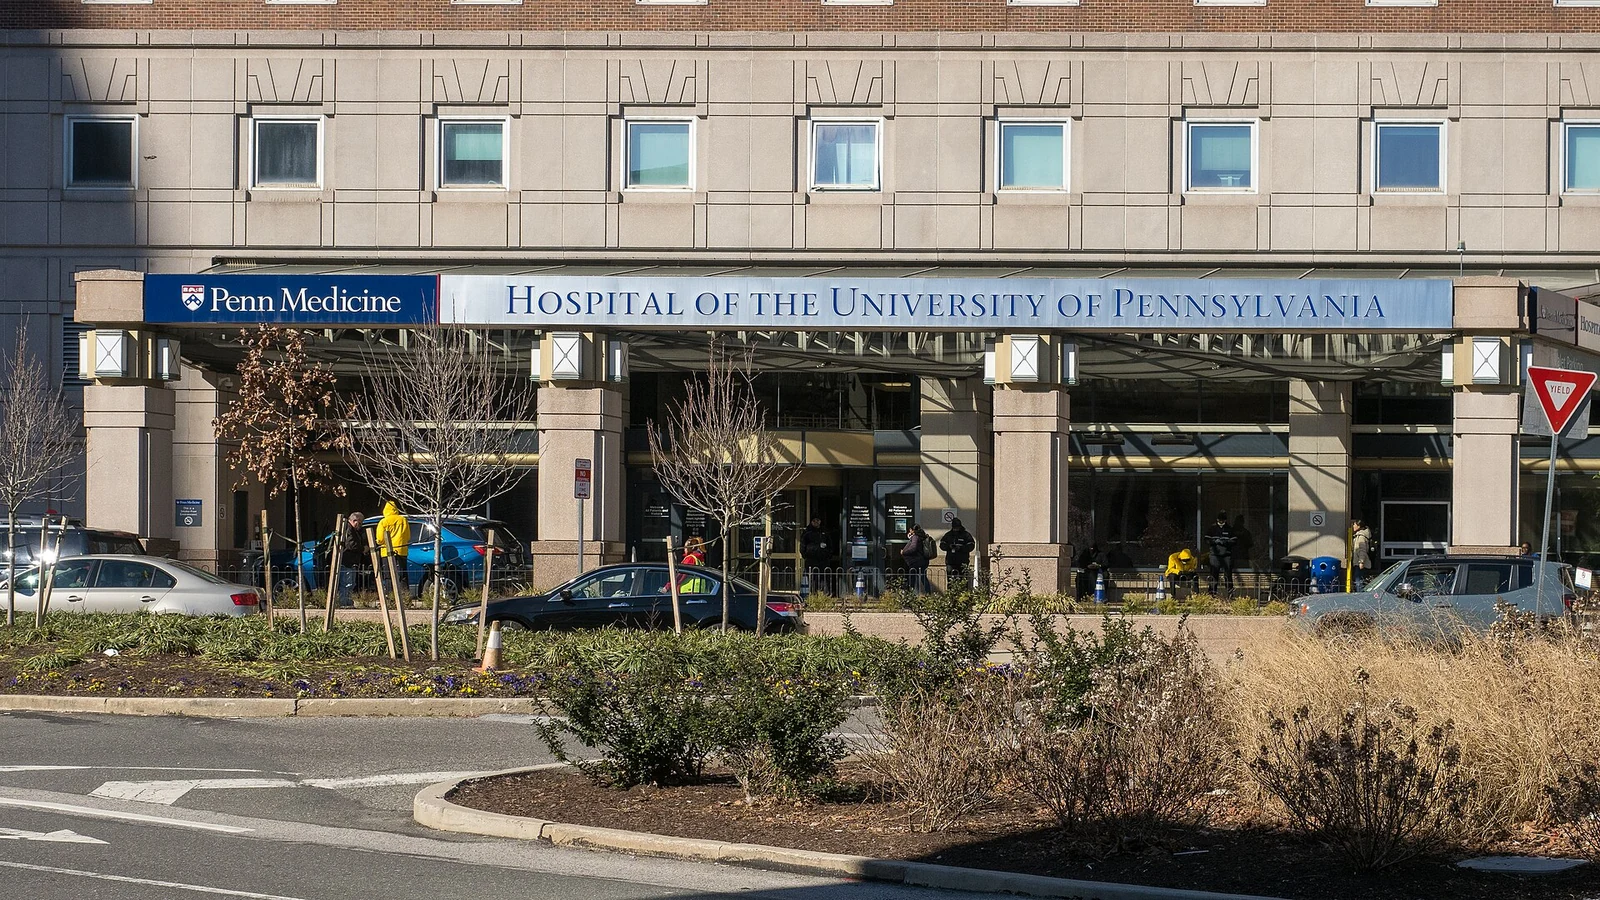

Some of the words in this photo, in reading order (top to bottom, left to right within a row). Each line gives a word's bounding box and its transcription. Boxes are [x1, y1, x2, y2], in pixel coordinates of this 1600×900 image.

[210, 287, 275, 312] Penn
[279, 285, 402, 313] Medicine
[506, 285, 685, 316] HOSPITAL
[695, 291, 740, 316] OF
[749, 293, 820, 317] THE
[830, 287, 1046, 318] UNIVERSITY
[1057, 293, 1102, 318] OF
[1113, 288, 1387, 319] PENNSYLVANIA
[1550, 385, 1571, 395] YIELD
